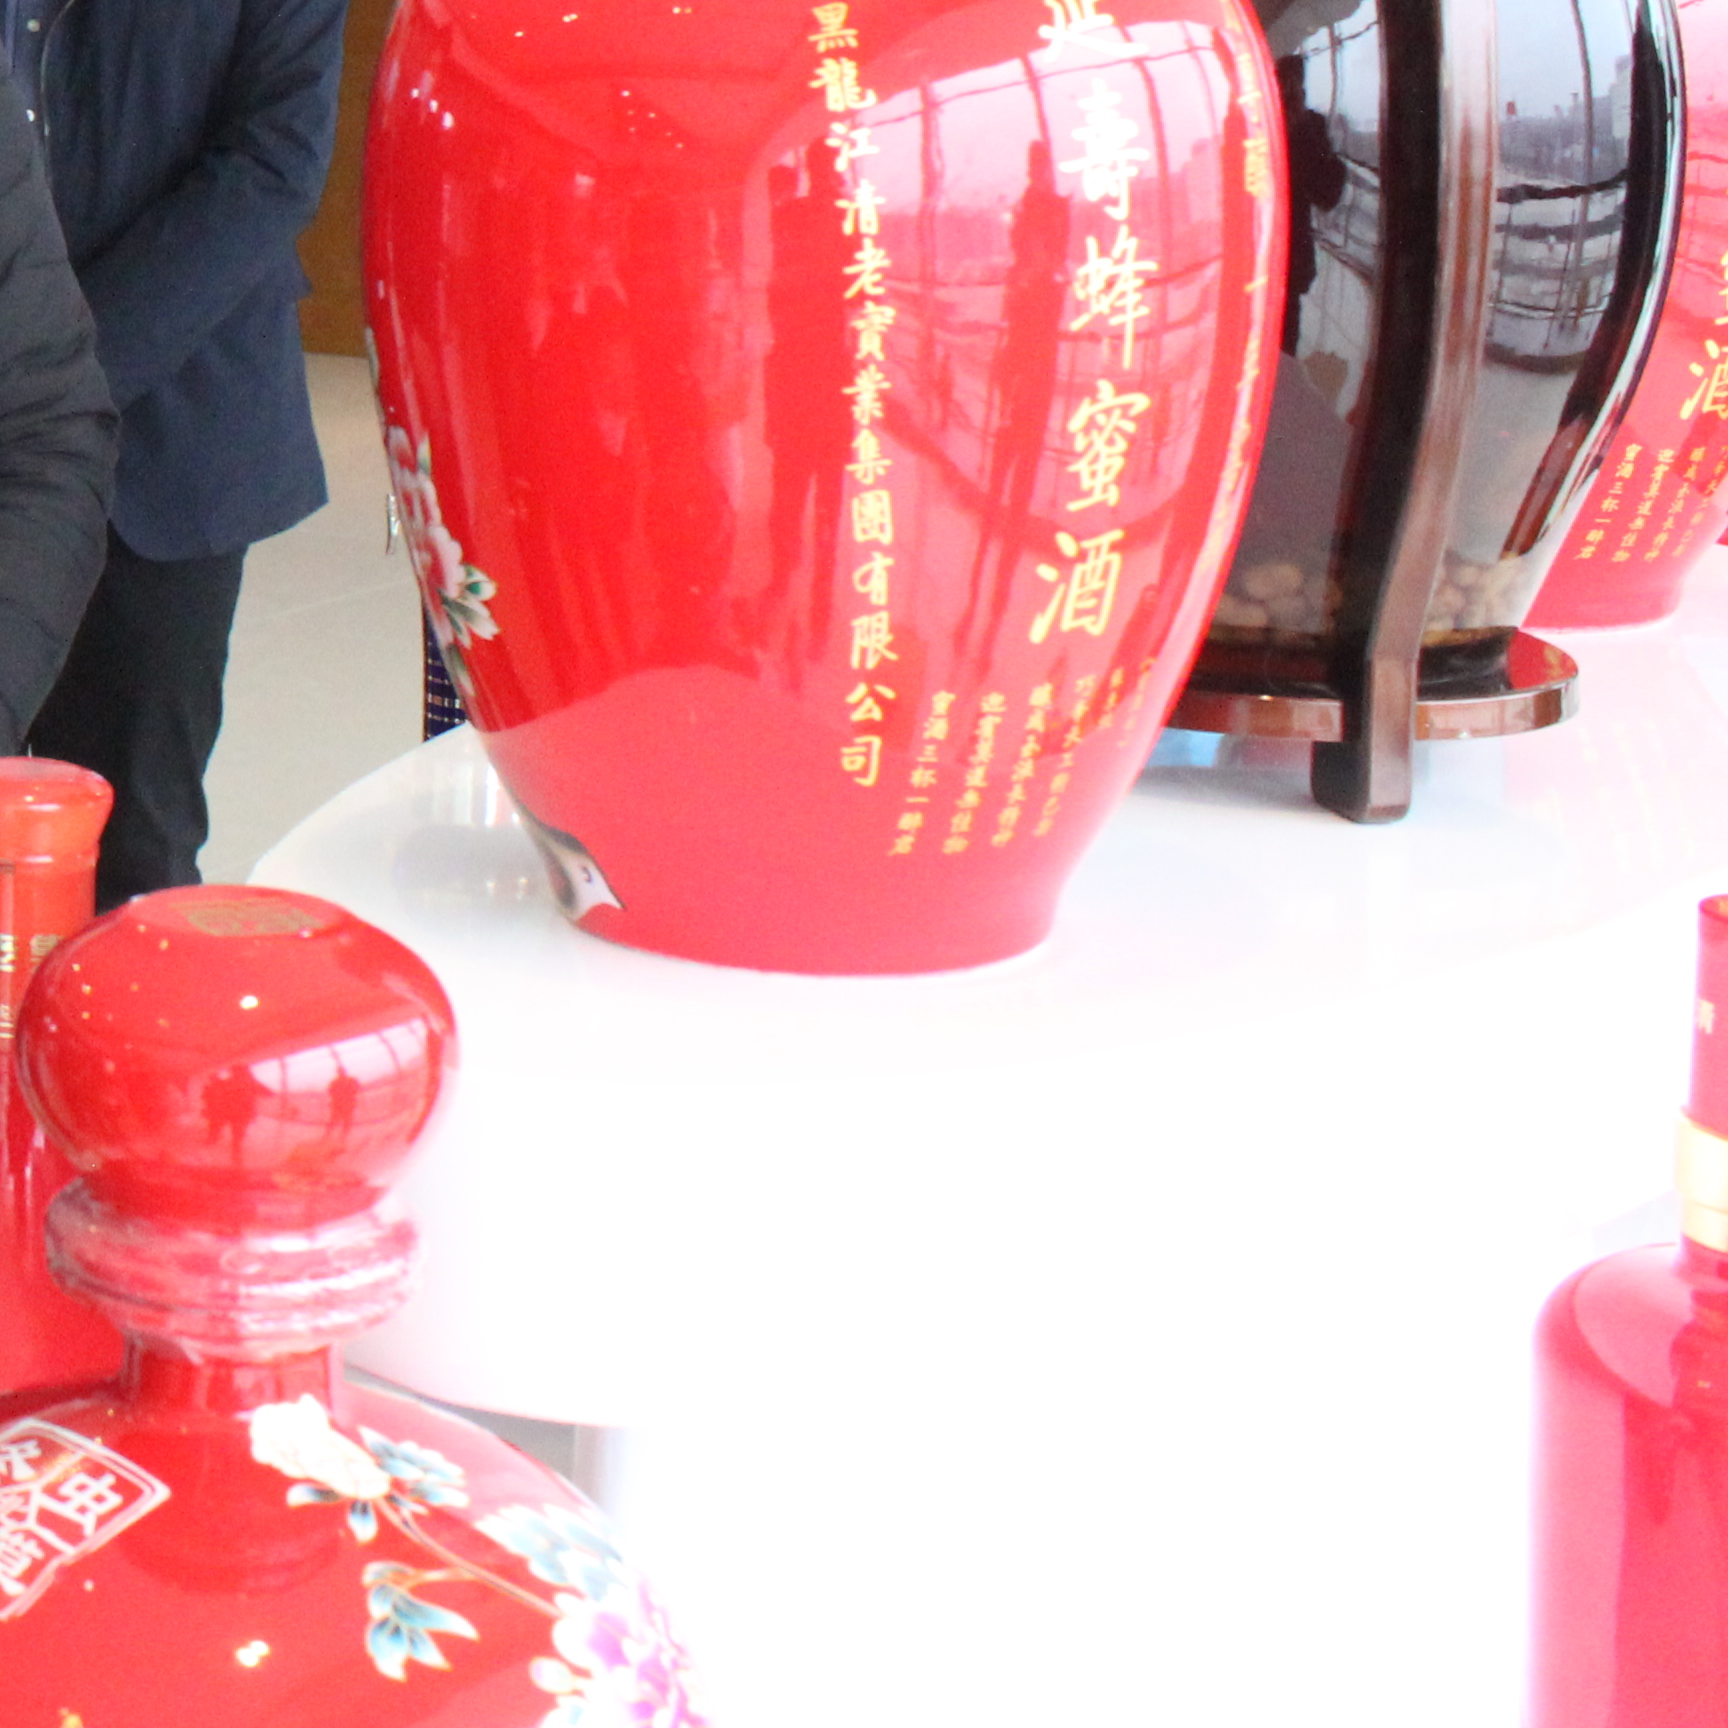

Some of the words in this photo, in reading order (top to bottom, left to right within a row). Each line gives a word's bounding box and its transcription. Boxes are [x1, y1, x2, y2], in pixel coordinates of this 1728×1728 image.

[806, 2, 897, 788] 黑龍江清老實業集團有限公司
